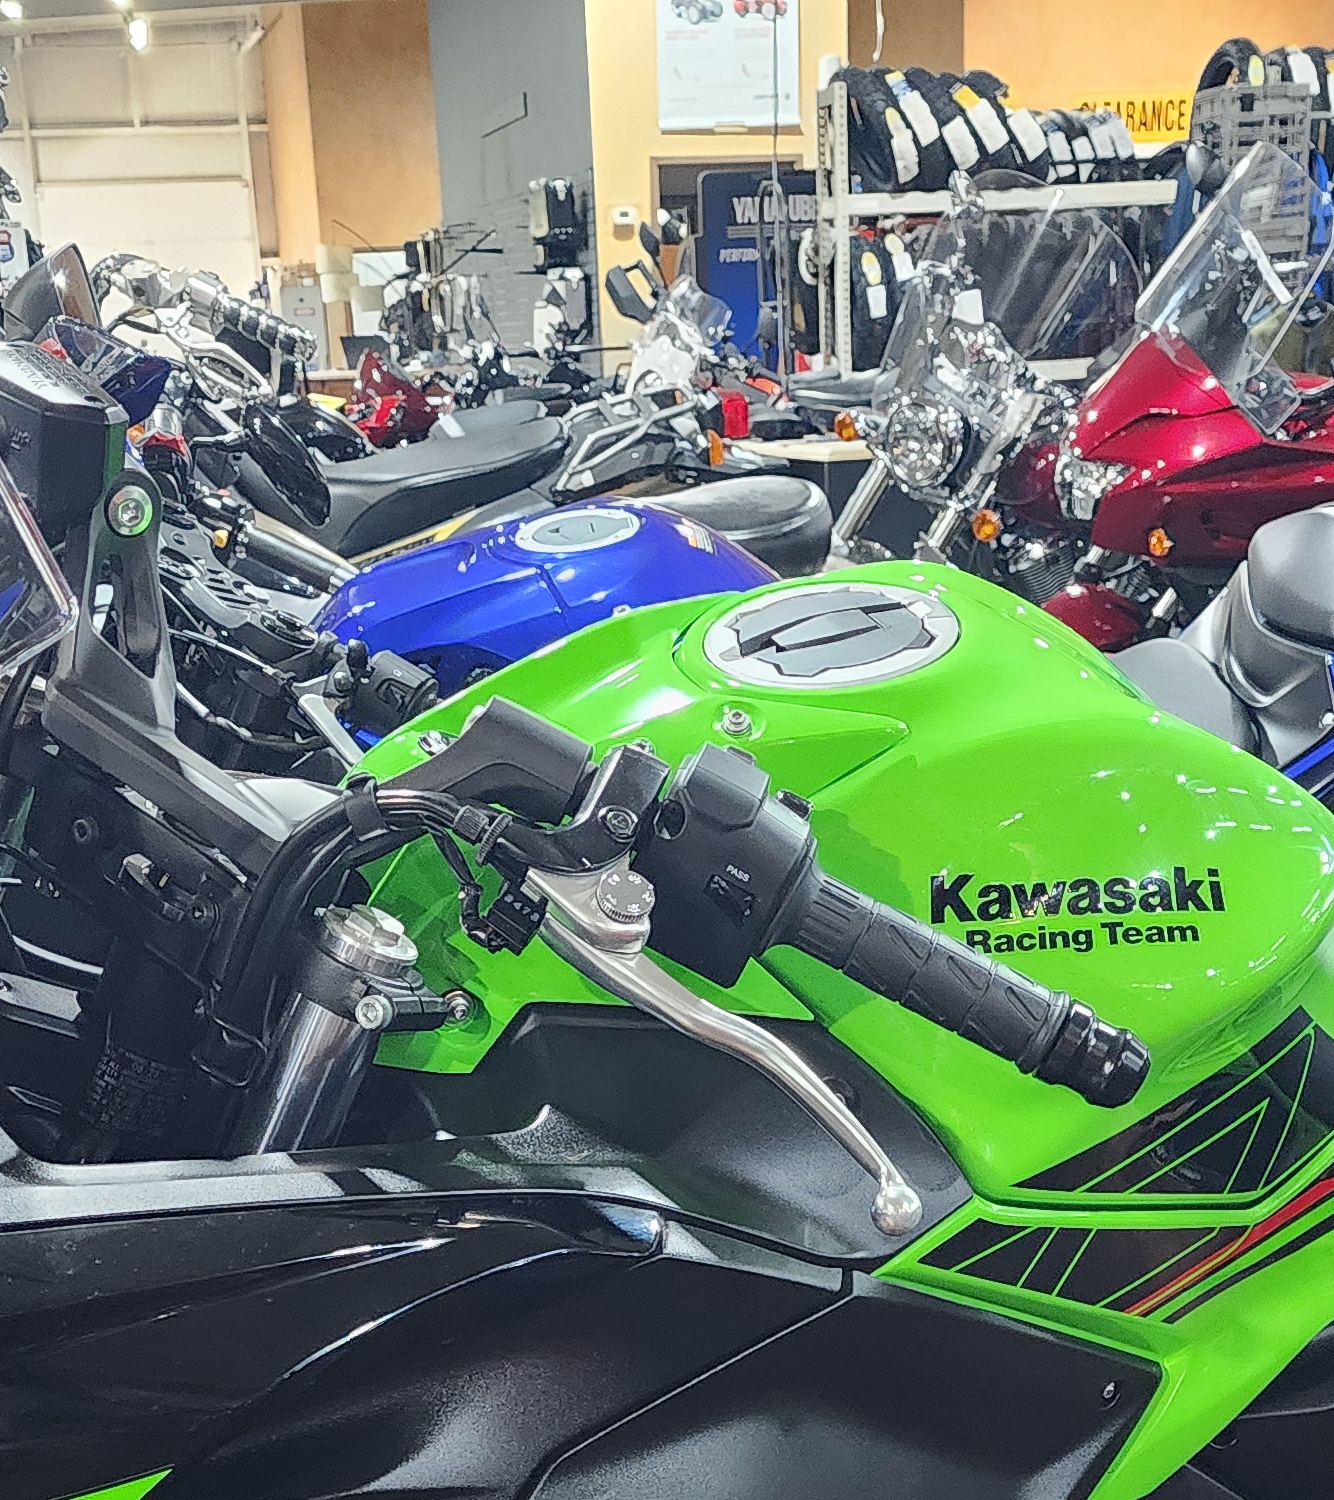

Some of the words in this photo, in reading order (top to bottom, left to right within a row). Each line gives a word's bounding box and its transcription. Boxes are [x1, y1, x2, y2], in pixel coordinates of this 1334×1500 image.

[1080, 99, 1187, 132] RANCE
[725, 864, 750, 883] PASS
[929, 866, 1226, 924] Kawasaki
[966, 925, 1093, 954] Racing
[1100, 920, 1201, 946] Team
